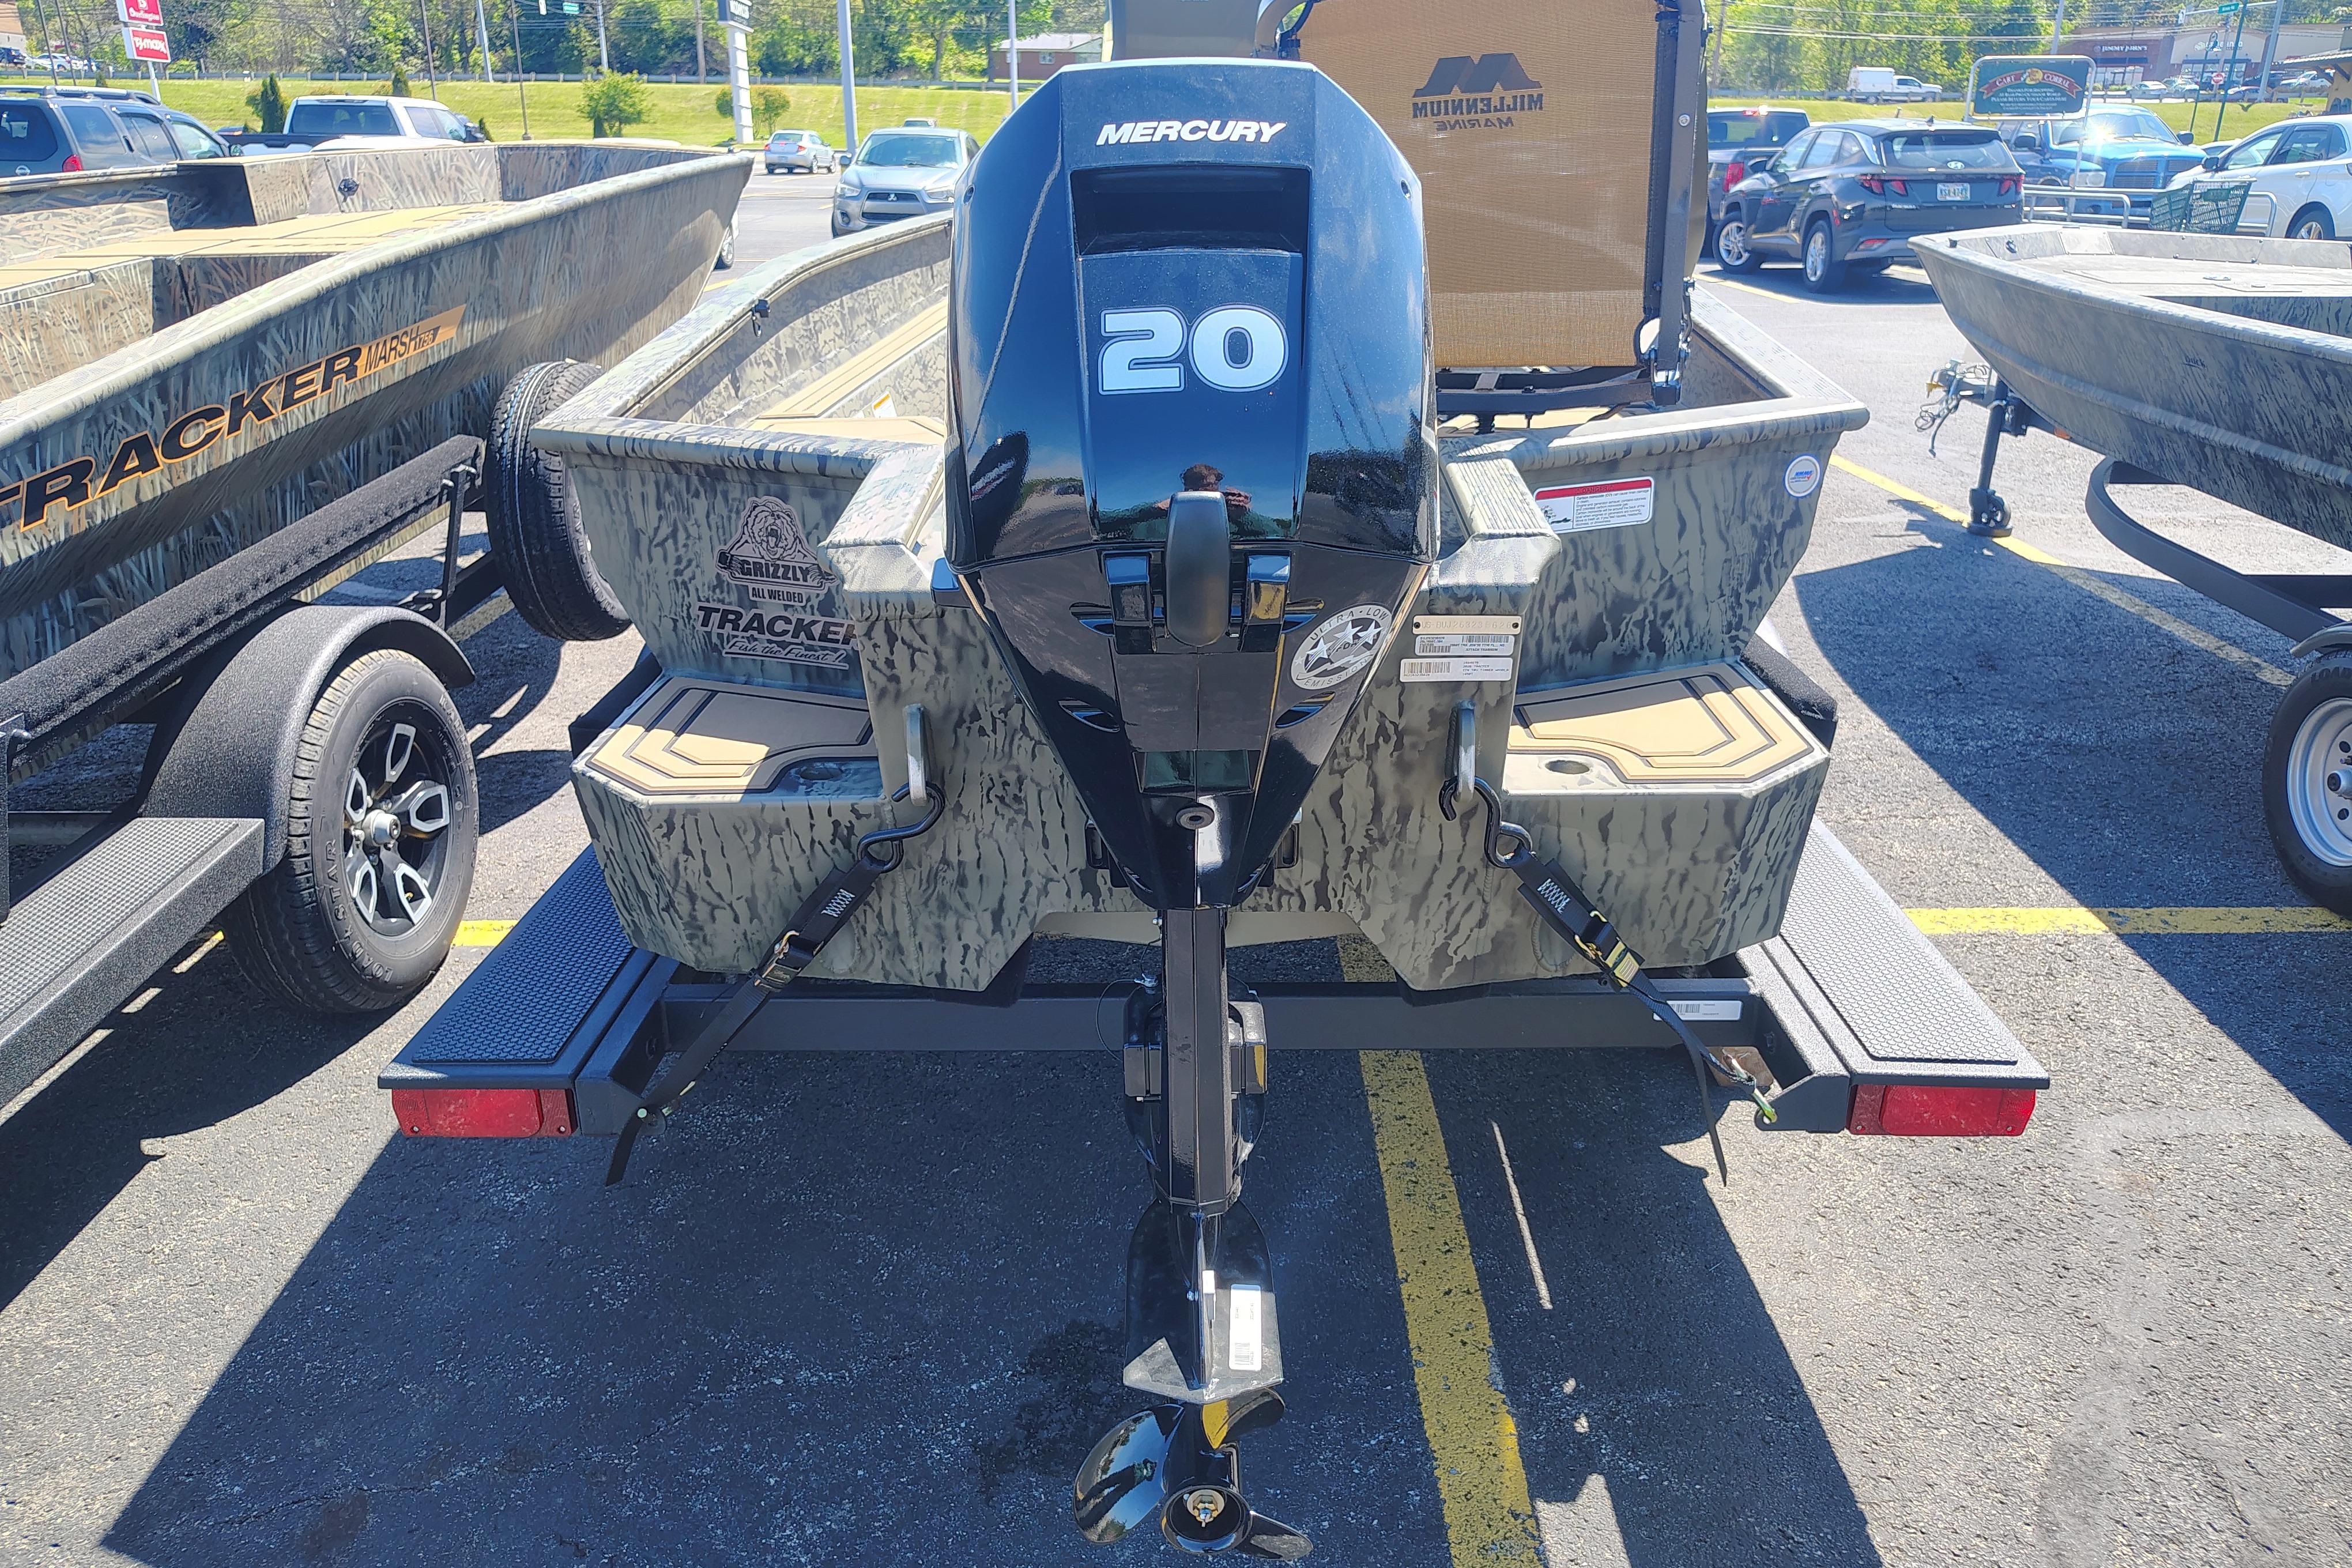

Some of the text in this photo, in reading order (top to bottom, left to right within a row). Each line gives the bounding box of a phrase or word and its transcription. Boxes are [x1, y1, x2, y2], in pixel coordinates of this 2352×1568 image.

[1096, 120, 1288, 146] MERCURY
[364, 325, 420, 375] MARSH
[1098, 303, 1290, 396] 20
[1582, 485, 1607, 494] DANGER
[740, 558, 810, 583] GRIZZLY
[751, 587, 804, 604] ALL WELDED
[1310, 607, 1389, 641] ULTRA LOW
[728, 639, 759, 653] Fish
[760, 644, 782, 657] the
[1303, 658, 1367, 687] EMISSION
[325, 838, 347, 921] STAR
